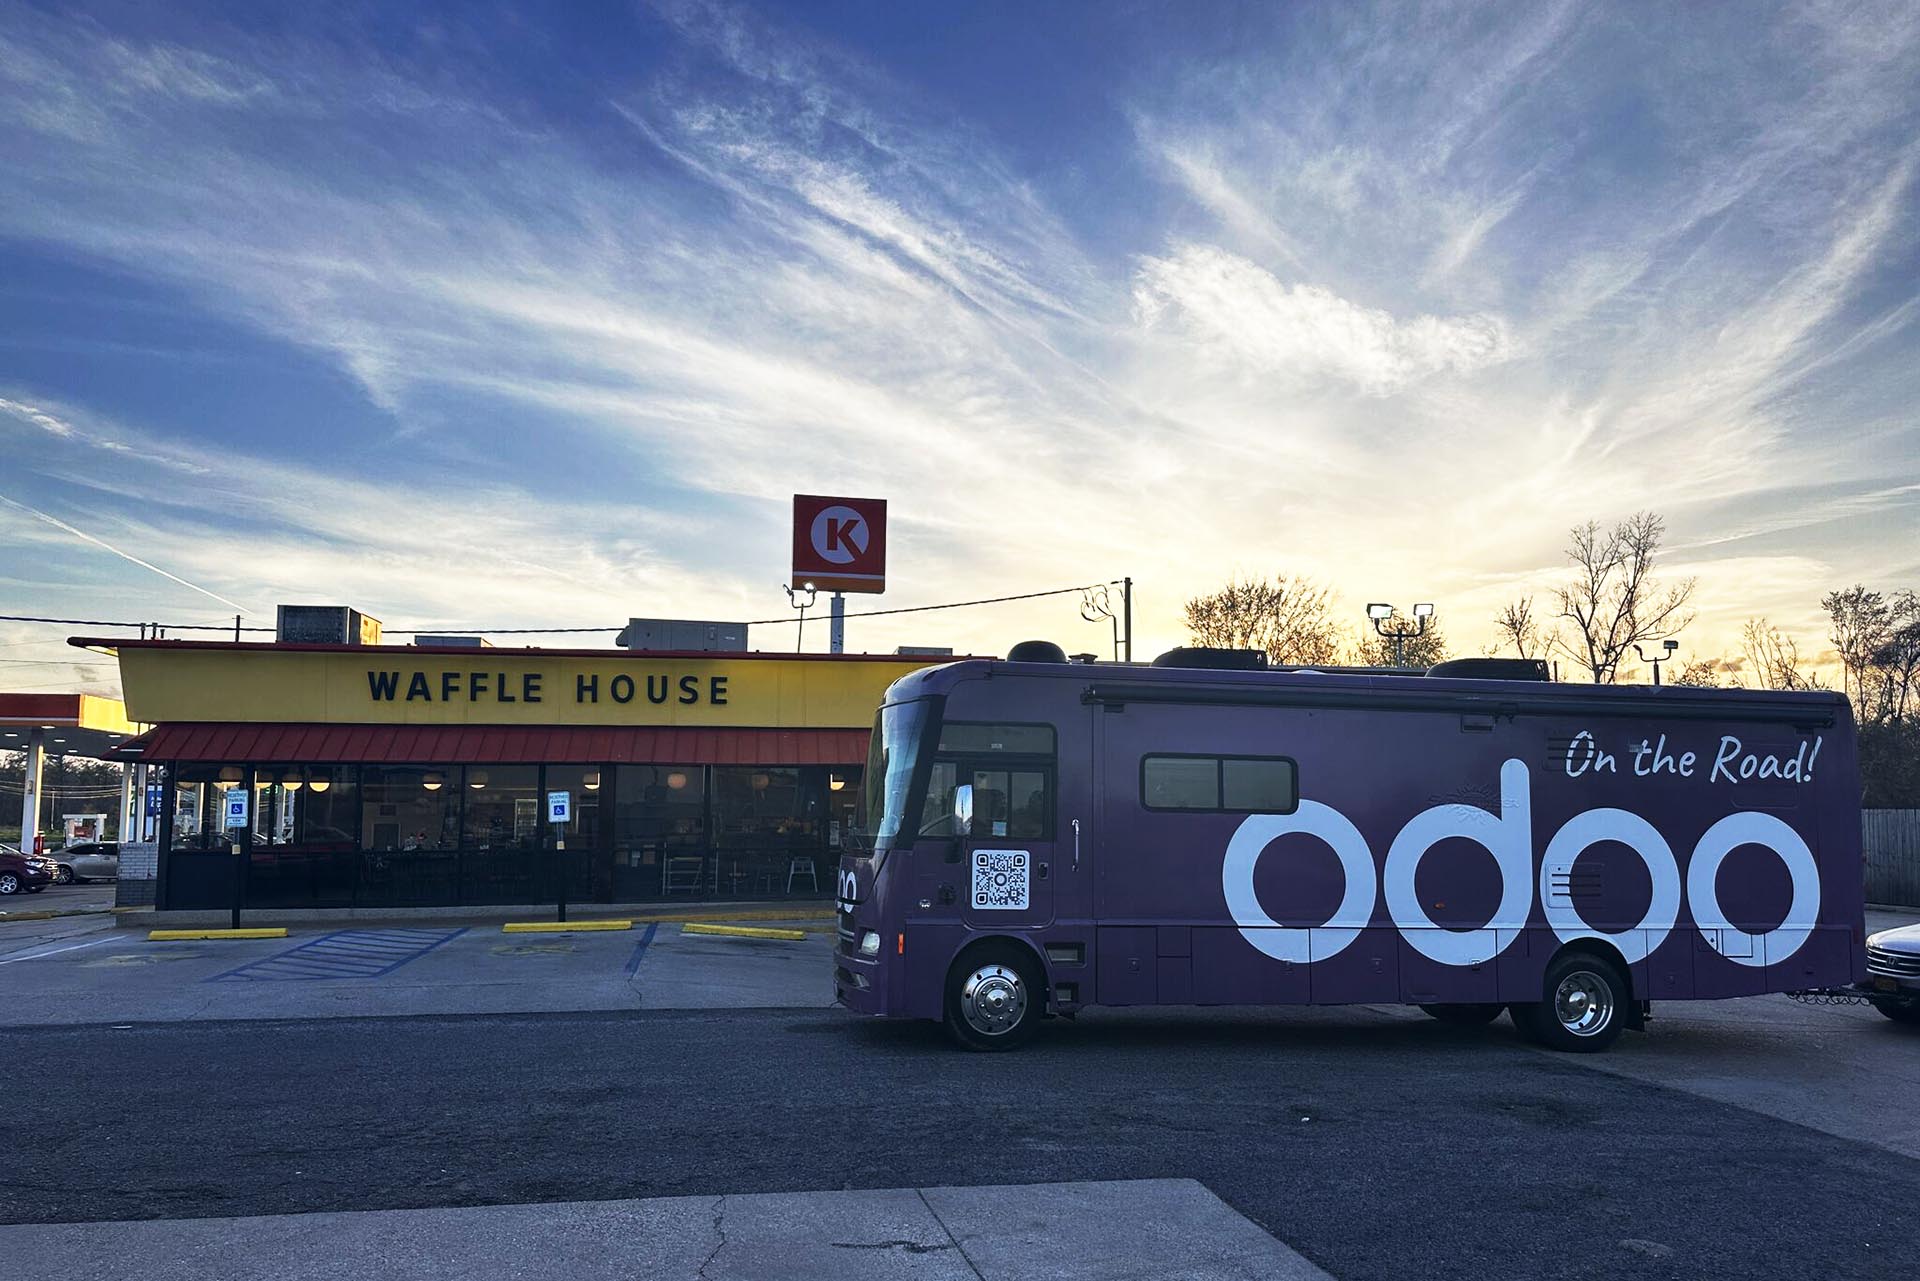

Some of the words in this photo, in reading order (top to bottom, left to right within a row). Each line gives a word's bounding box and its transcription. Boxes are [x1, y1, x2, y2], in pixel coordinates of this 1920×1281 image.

[825, 516, 864, 561] K
[367, 671, 542, 702] WAFFLE
[576, 674, 729, 705] HOUSE
[1565, 730, 1617, 778] On
[1634, 733, 1696, 777] the
[1710, 735, 1823, 784] Road!
[1222, 758, 1821, 967] odoo
